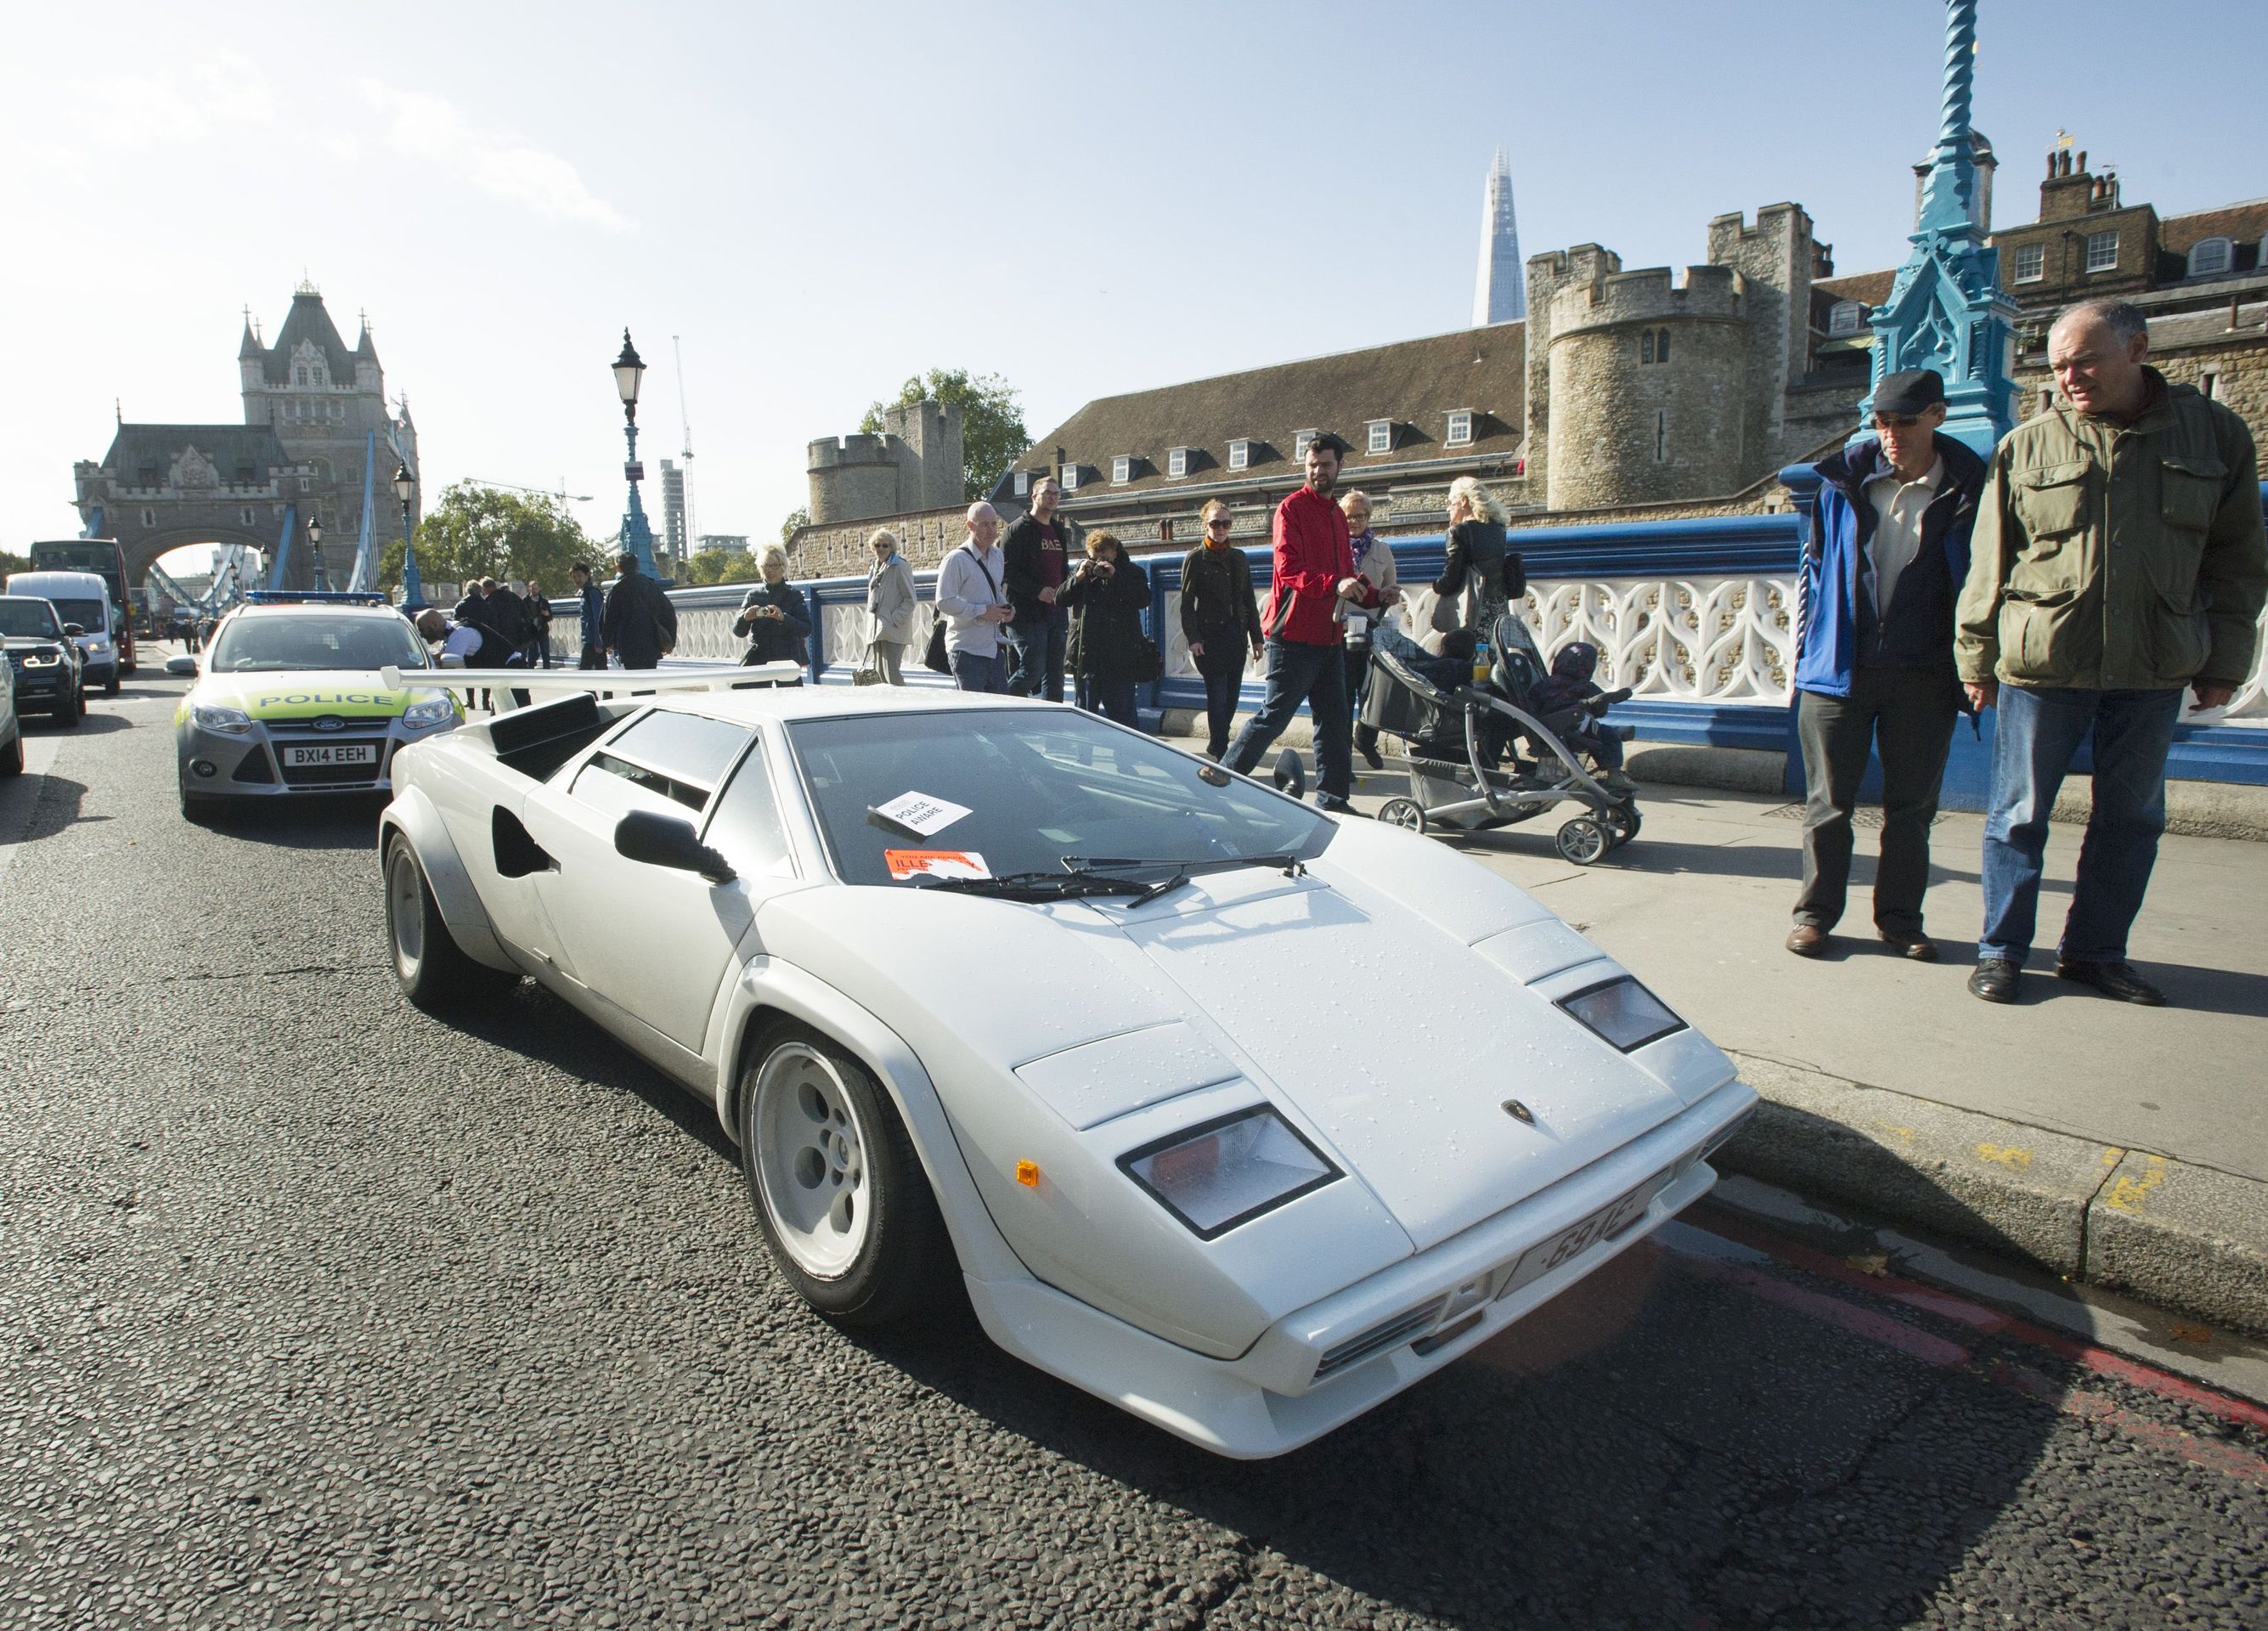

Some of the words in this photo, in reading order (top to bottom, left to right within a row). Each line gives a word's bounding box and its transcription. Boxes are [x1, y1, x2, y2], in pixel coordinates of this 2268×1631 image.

[260, 694, 394, 708] POLICE
[295, 748, 330, 764] BX14
[336, 748, 366, 762] EEH
[895, 801, 930, 820] POLICE
[911, 806, 943, 825] AWARE
